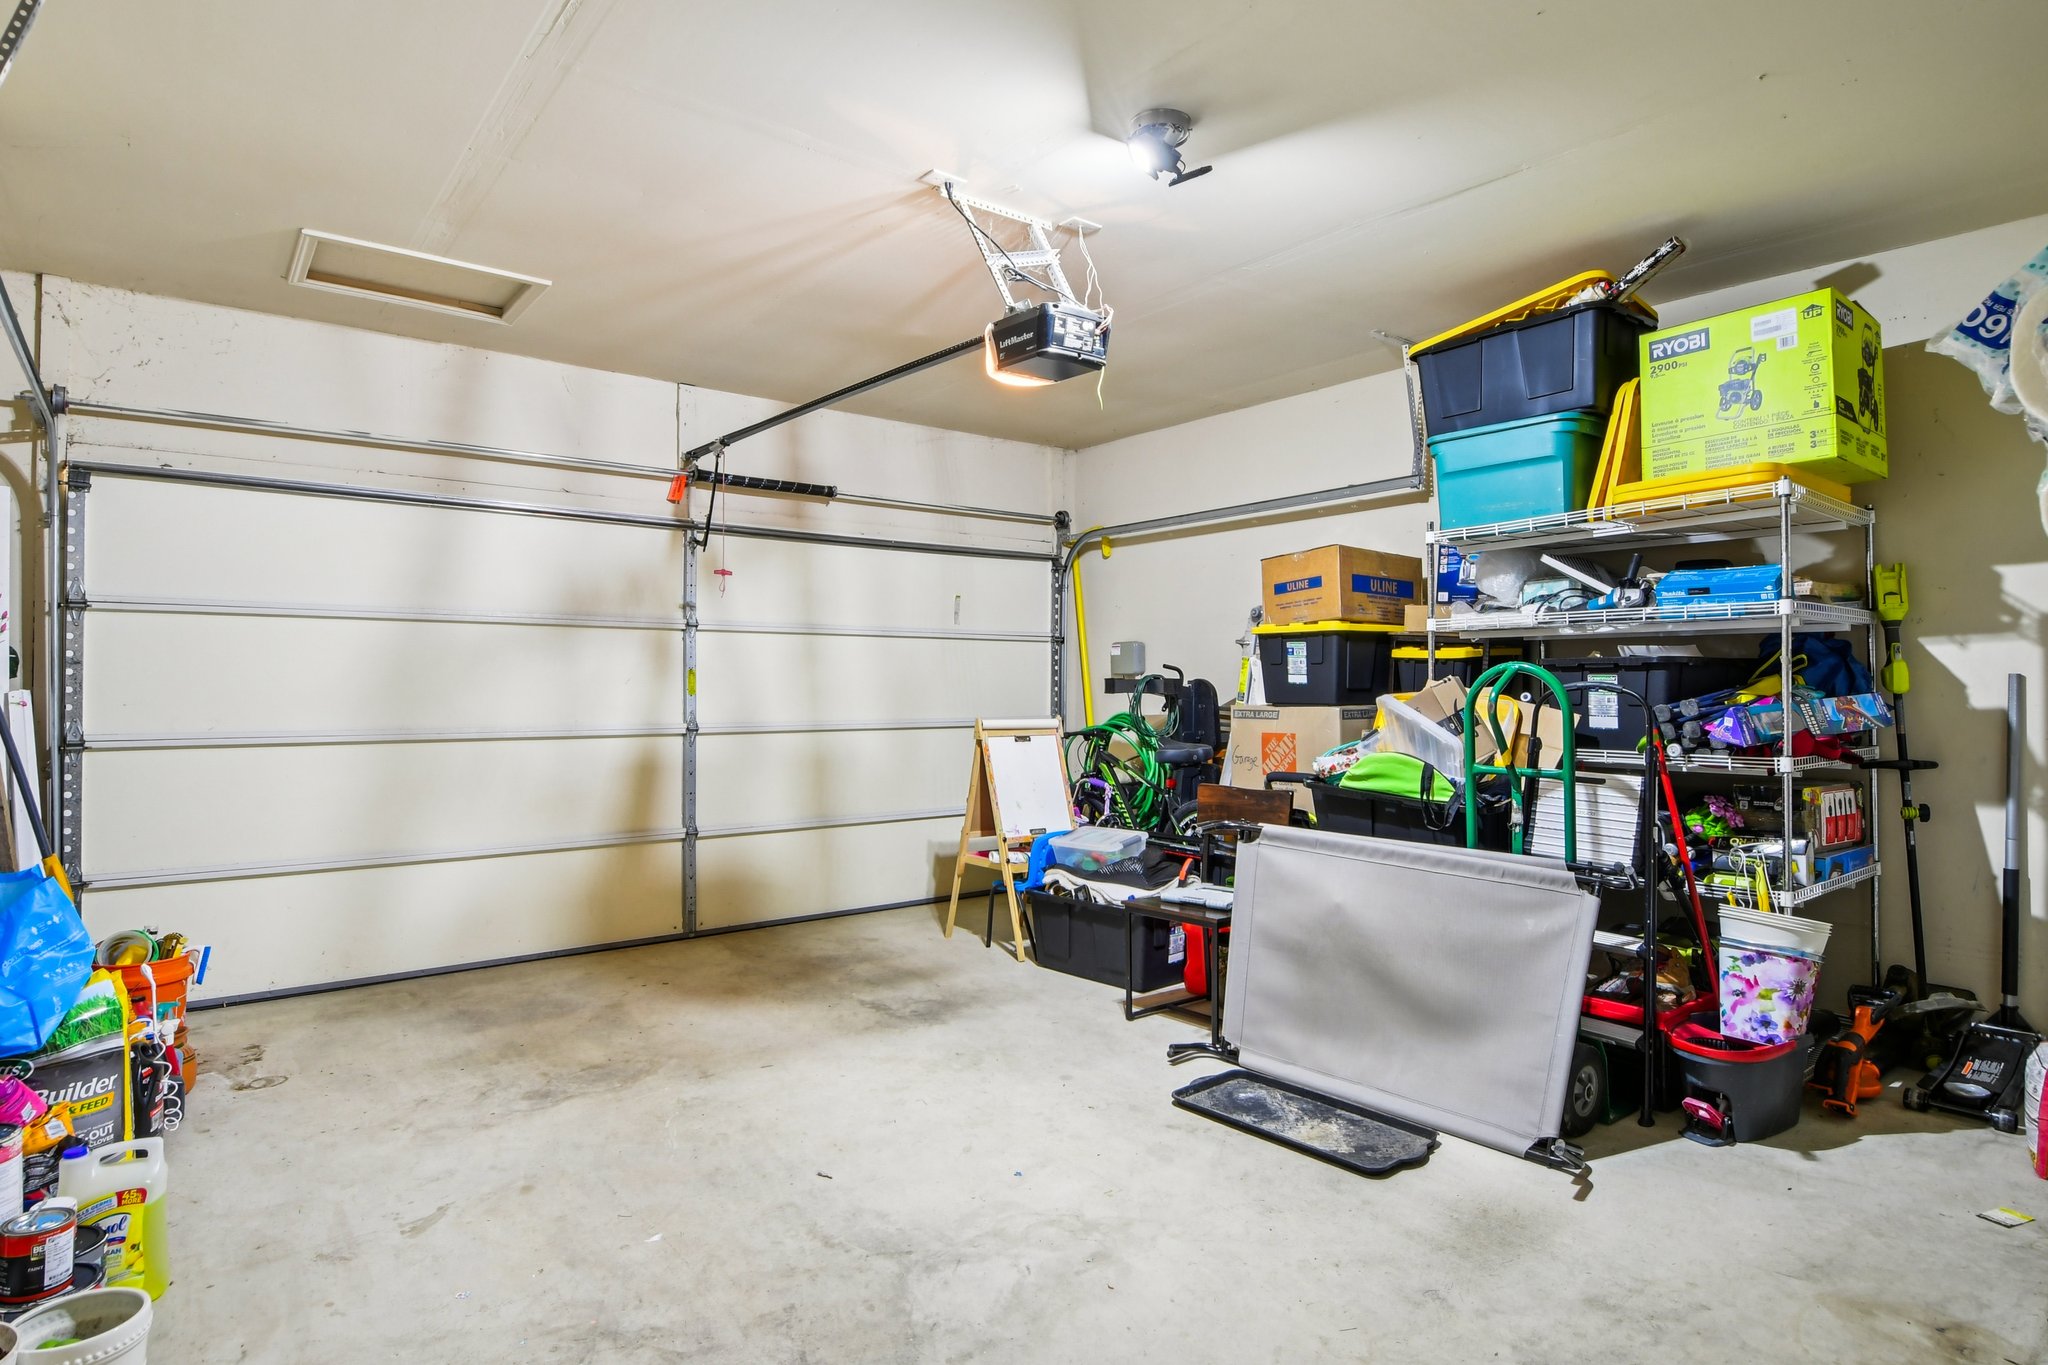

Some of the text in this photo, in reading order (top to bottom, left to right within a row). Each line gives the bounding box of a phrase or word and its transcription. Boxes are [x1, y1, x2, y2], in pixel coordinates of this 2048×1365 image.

[1803, 309, 1822, 320] UP
[1836, 303, 1852, 326] RYOBI
[1000, 332, 1034, 348] LiftMaster
[1652, 332, 1706, 358] RYOBI
[1650, 361, 1678, 374] 2900
[1810, 430, 1816, 439] 3
[1810, 440, 1817, 448] 3
[1286, 580, 1309, 592] ULINE
[1370, 578, 1398, 594] ULINE
[1234, 710, 1254, 718] EXTRA
[1344, 711, 1360, 719] EXTRA
[1263, 733, 1296, 773] HOME
[1264, 737, 1279, 754] THE
[36, 1074, 118, 1106] Builder
[80, 1096, 108, 1112] FEED
[88, 1134, 114, 1148] CLOVER
